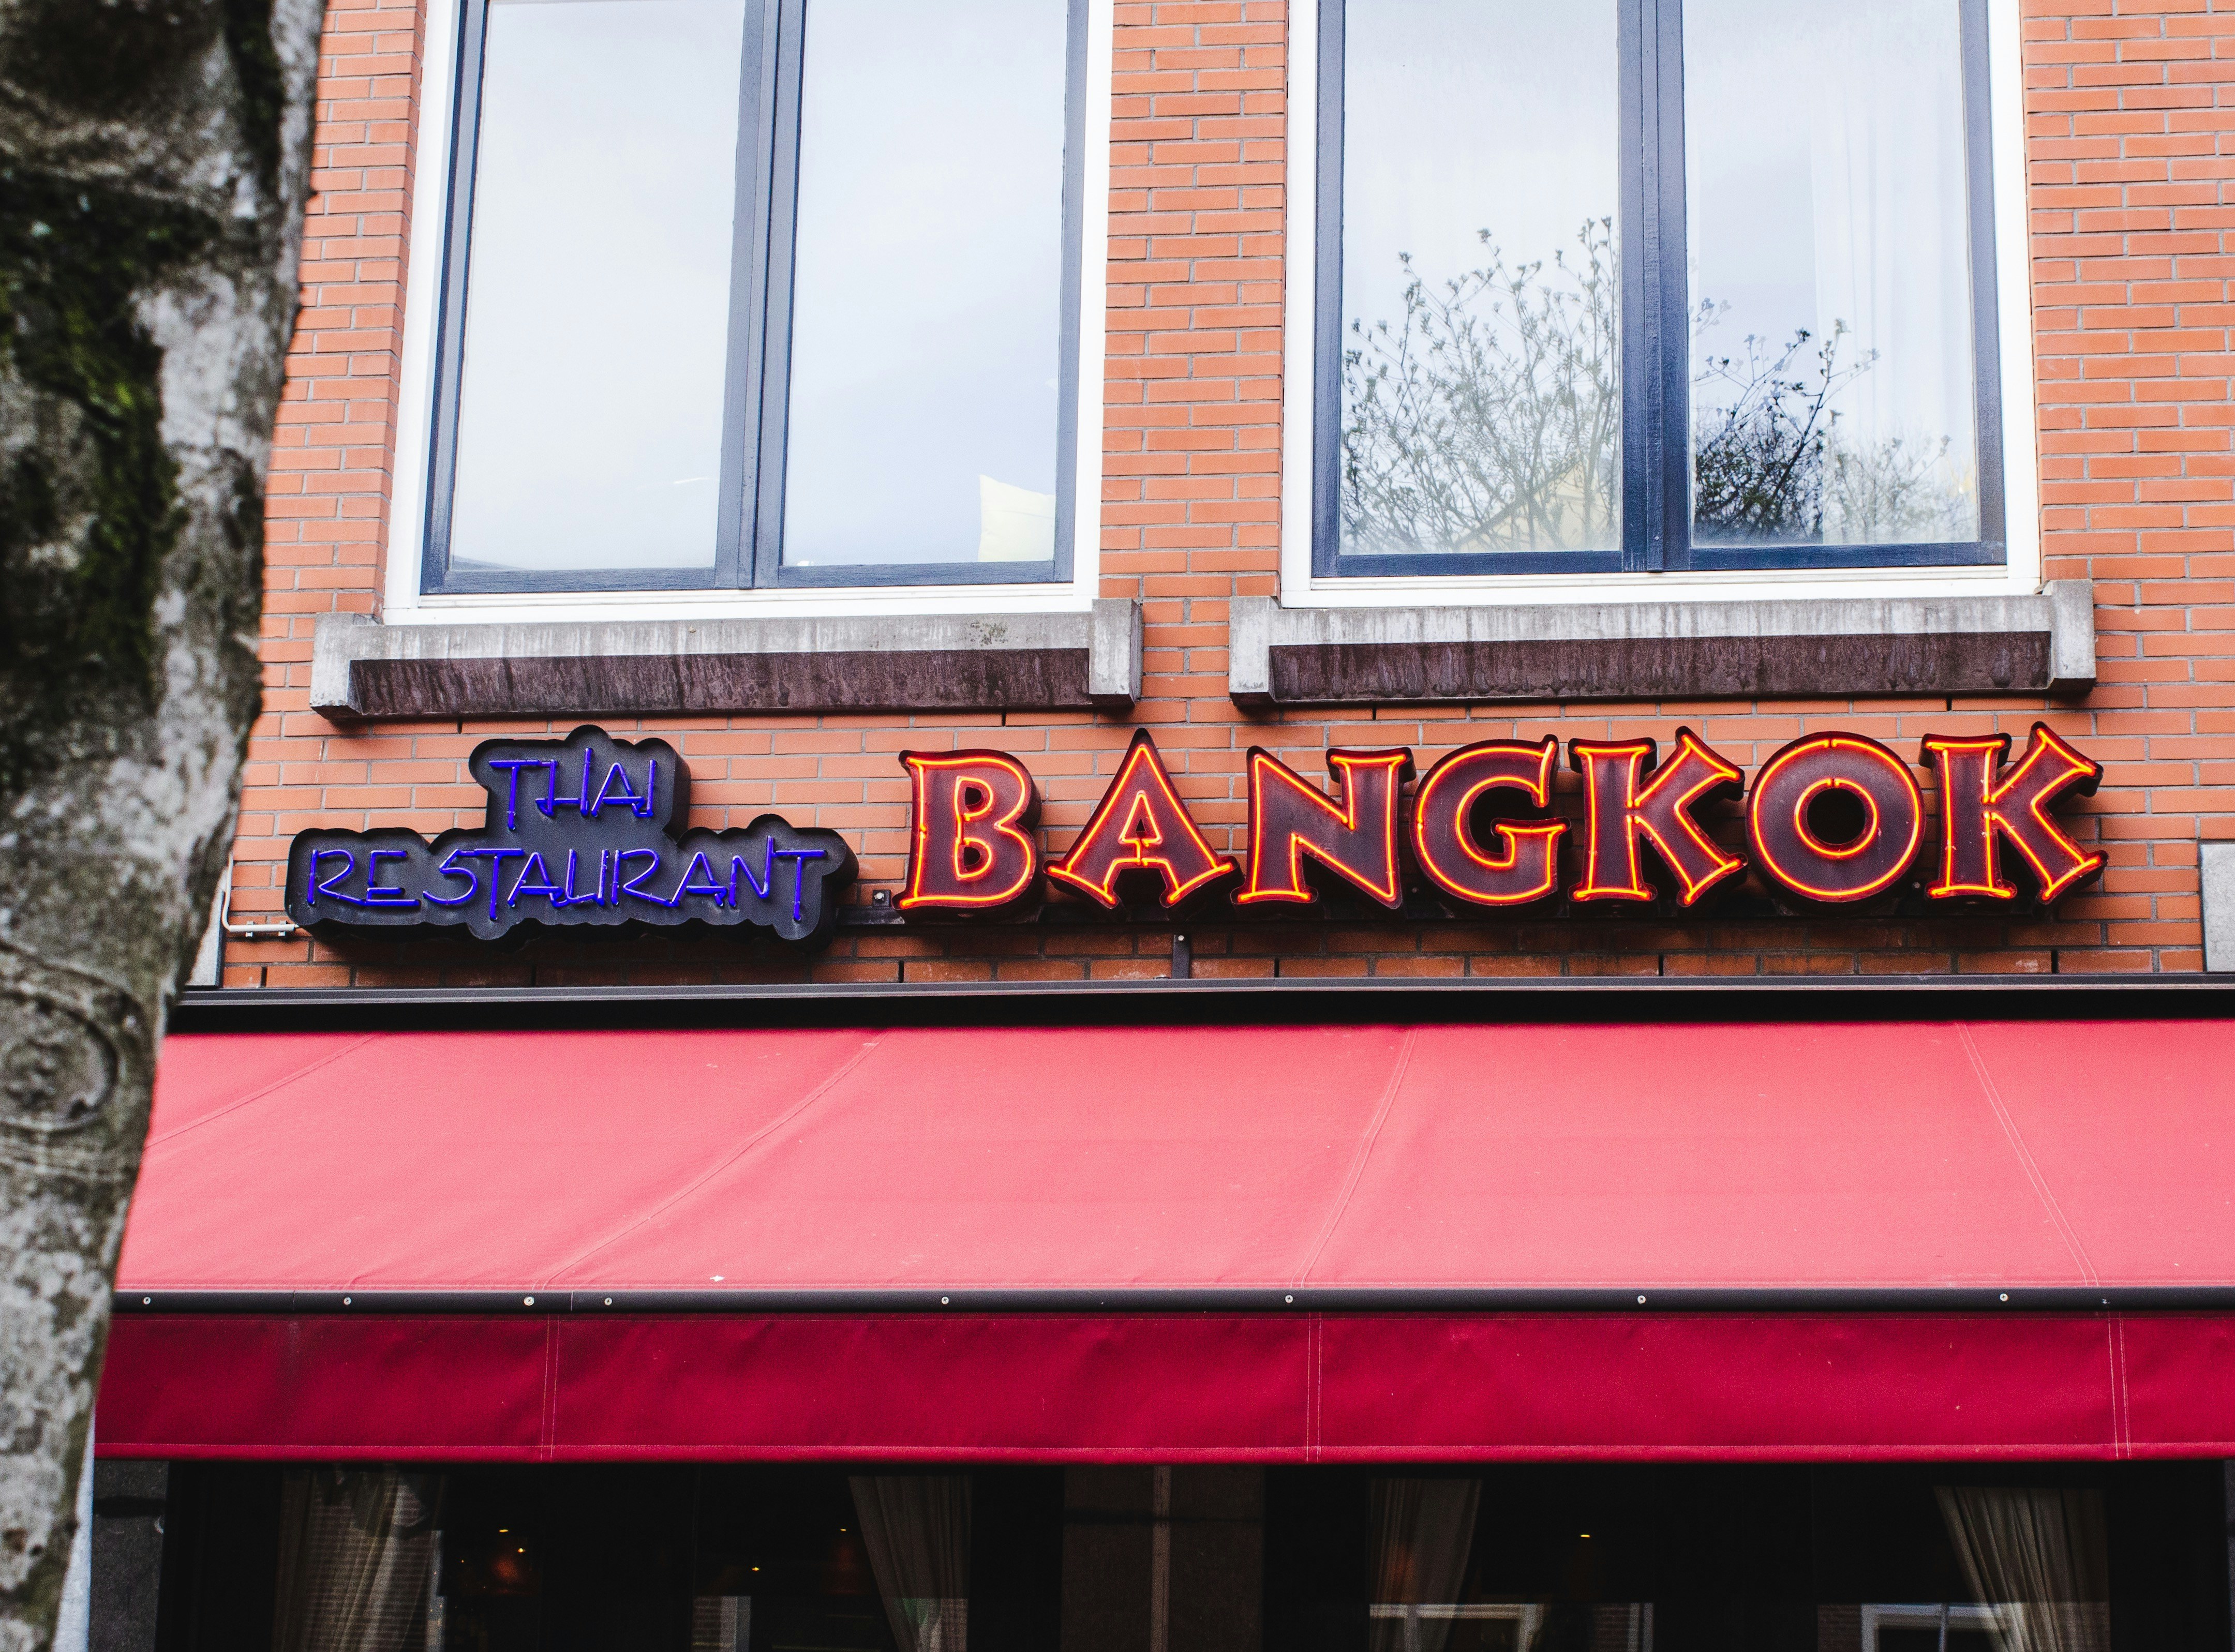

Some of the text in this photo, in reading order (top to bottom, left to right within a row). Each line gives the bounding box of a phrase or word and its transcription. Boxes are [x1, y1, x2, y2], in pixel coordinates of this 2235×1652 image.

[489, 747, 658, 830] THAI
[892, 722, 2108, 909] BANGKOK
[307, 835, 828, 921] RESTAURANT
